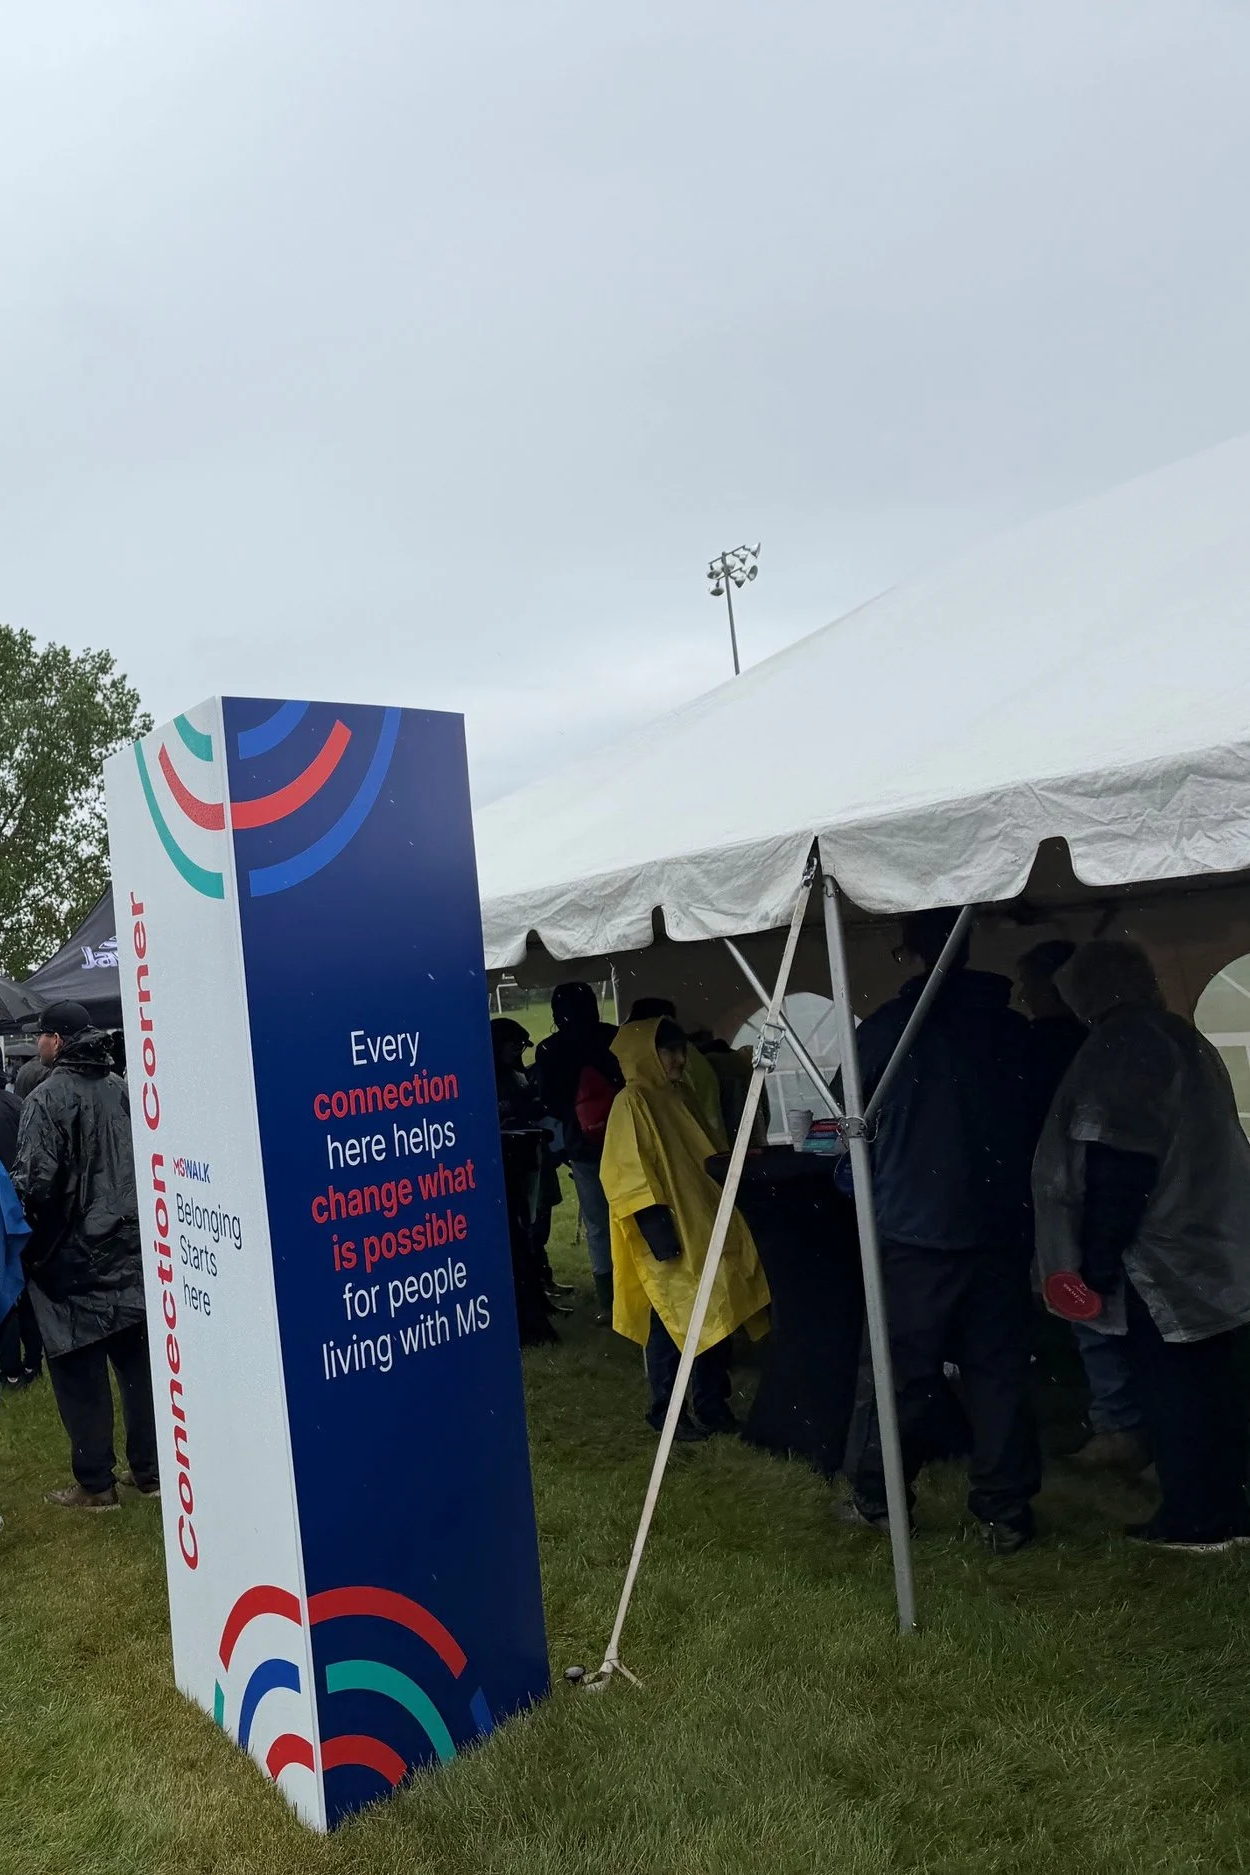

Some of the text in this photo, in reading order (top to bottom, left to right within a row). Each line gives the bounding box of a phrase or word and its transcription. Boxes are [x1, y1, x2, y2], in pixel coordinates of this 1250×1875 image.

[81, 946, 119, 969] Ja
[350, 1030, 420, 1067] Every
[313, 1069, 459, 1121] connection
[327, 1118, 456, 1170] here helps
[173, 1157, 211, 1184] MSWALK
[311, 1159, 476, 1224] change what
[130, 891, 199, 1571] Connection Corner
[177, 1193, 243, 1250] Belonging
[332, 1209, 468, 1274] is possible
[180, 1236, 218, 1277] Starts
[183, 1276, 212, 1317] here
[342, 1257, 467, 1321] for people
[322, 1294, 491, 1380] living with MS
